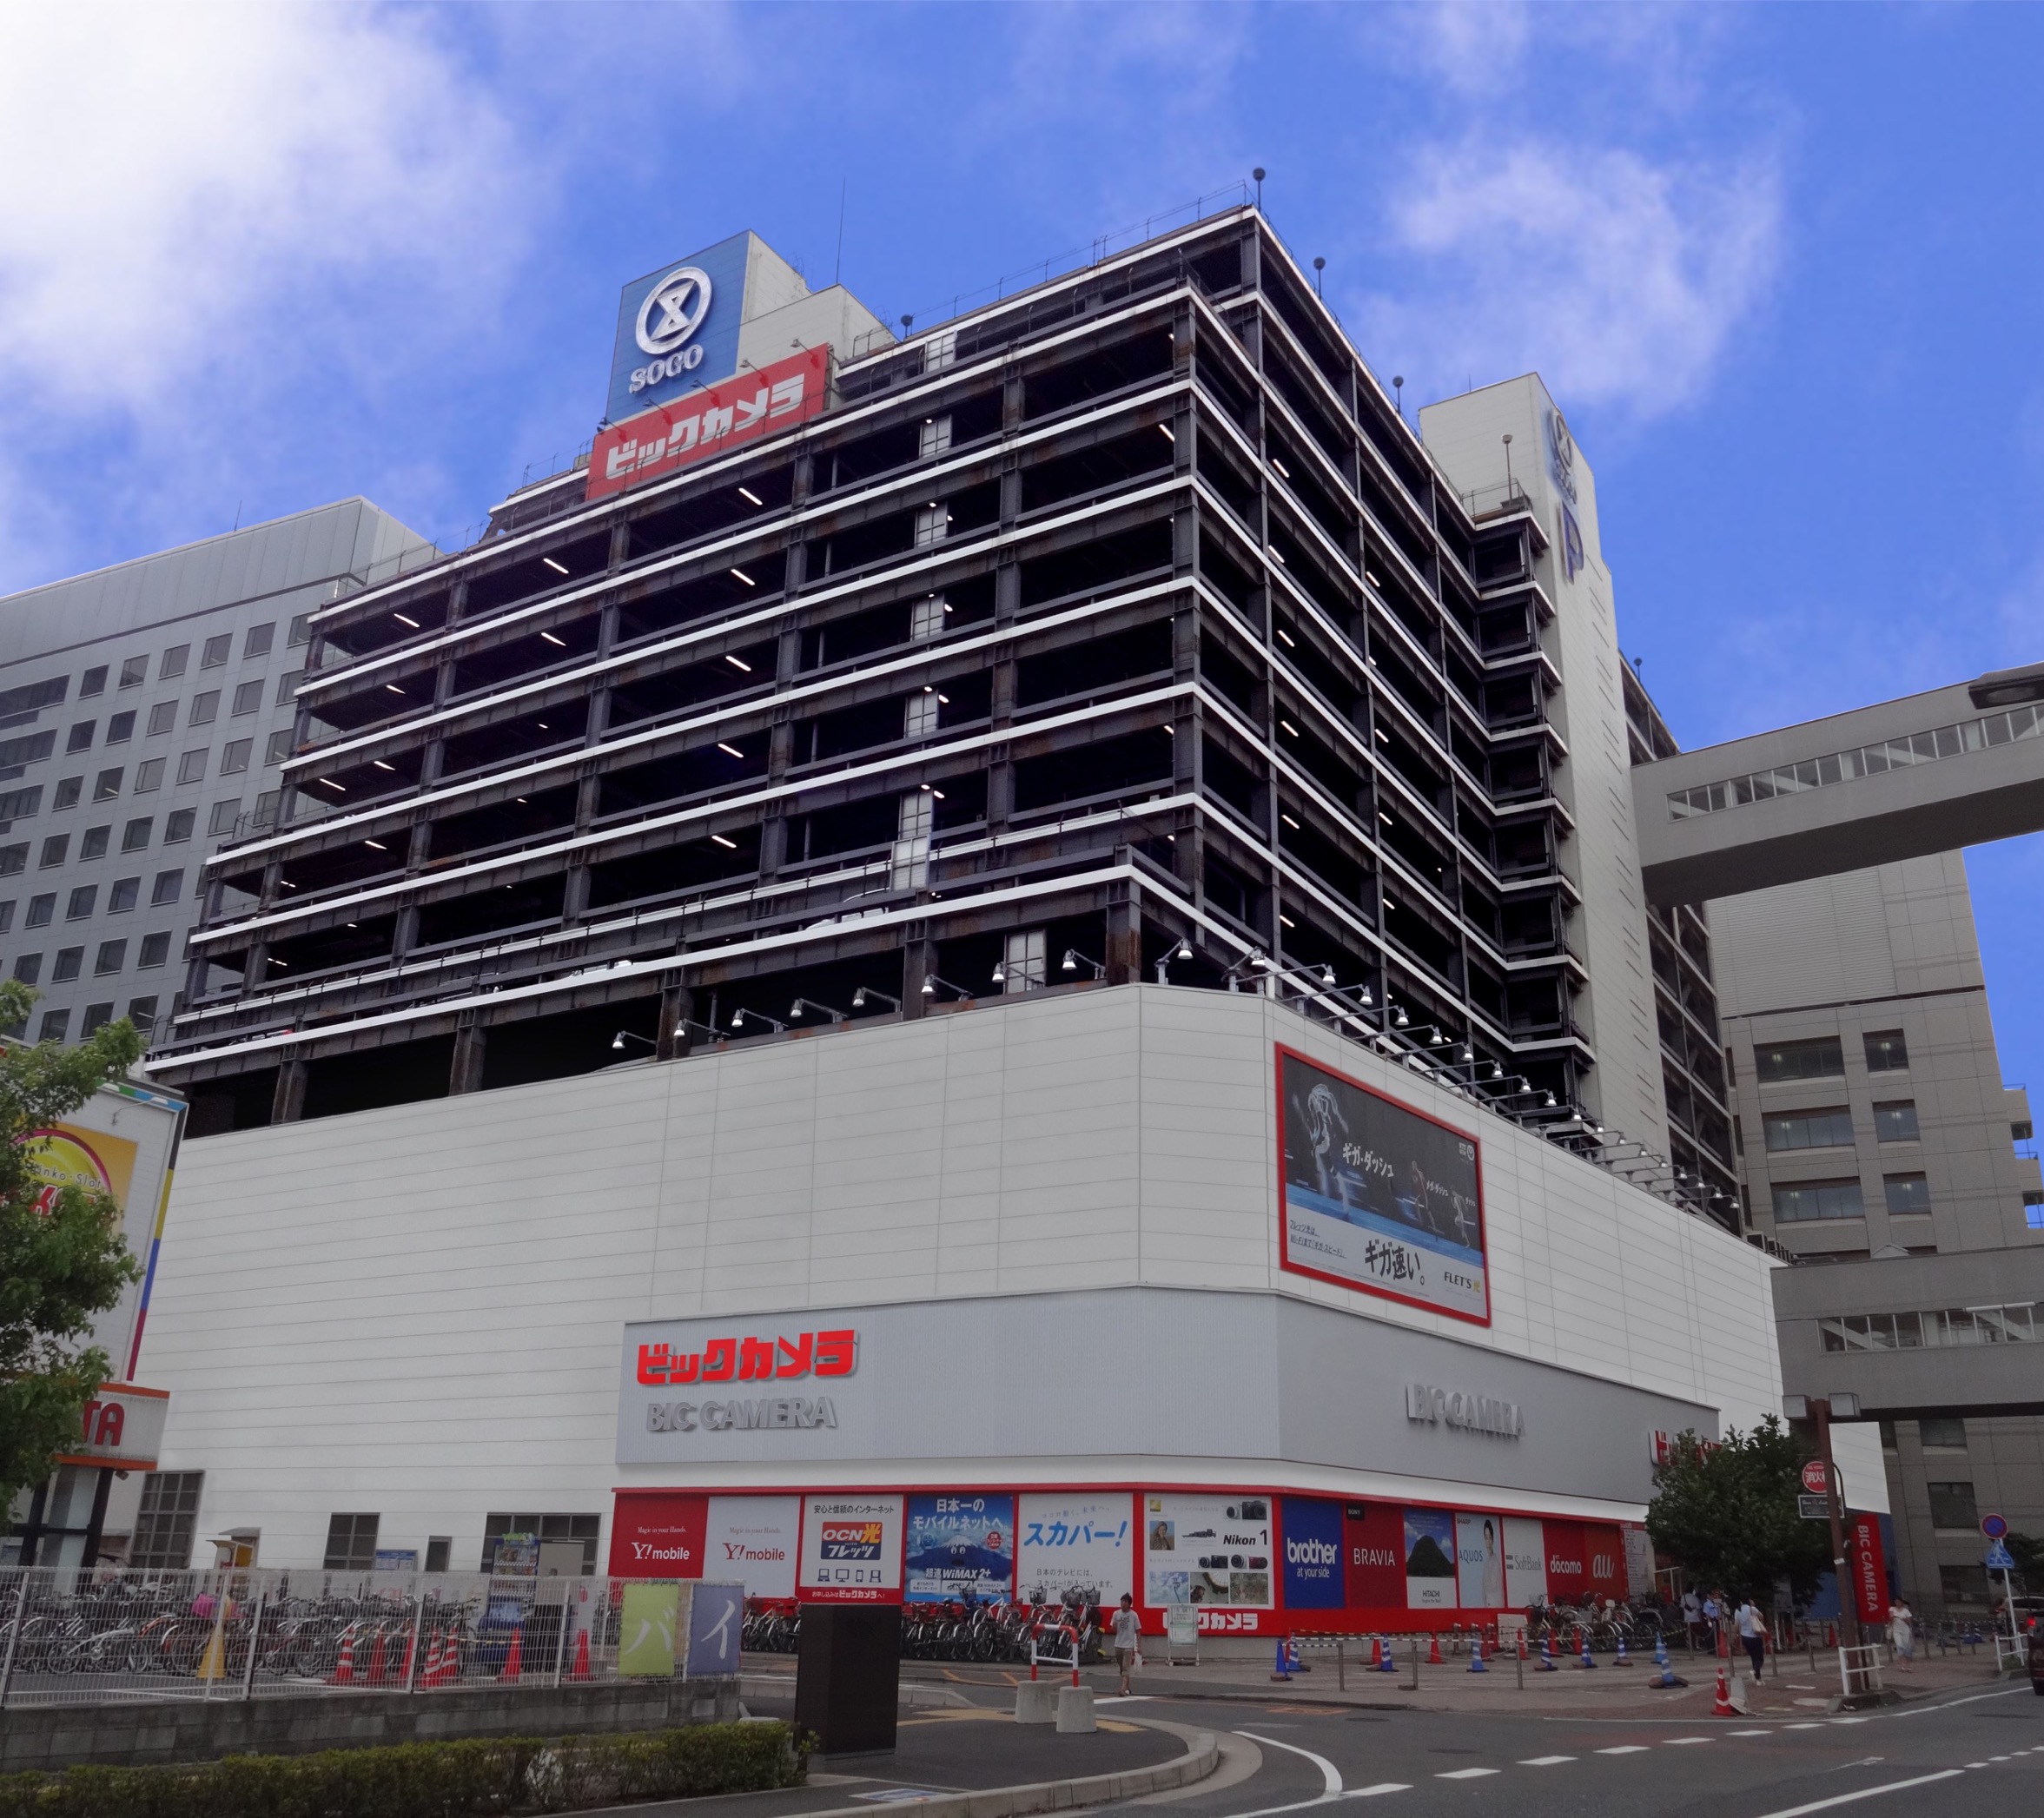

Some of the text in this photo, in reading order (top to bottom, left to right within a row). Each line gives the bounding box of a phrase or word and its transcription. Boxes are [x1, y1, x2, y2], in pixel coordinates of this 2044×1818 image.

[629, 344, 704, 394] SOGO
[605, 373, 805, 479] ビックカメラ
[76, 1173, 102, 1189] Slot
[1364, 1239, 1426, 1286] ギガ速い。
[636, 1329, 859, 1386] ビックカメラ
[646, 1396, 837, 1431] BIC CAMERA
[1407, 1384, 1525, 1438] BIC CAMERA
[813, 1504, 895, 1514] 安心と信頼のインターネット
[936, 1497, 985, 1513] 日本一の
[912, 1515, 1009, 1530] モバイルネットへ。
[1223, 1534, 1256, 1546] Nikon
[1260, 1529, 1267, 1545] 1
[828, 1545, 875, 1558] フレッツ
[1287, 1537, 1338, 1564] brother
[1353, 1547, 1396, 1567] BRAVIA
[1459, 1549, 1484, 1564] AQUOS
[1514, 1554, 1543, 1571] SoftBank
[1551, 1555, 1583, 1575] docomo
[1592, 1554, 1616, 1579] au
[1856, 1524, 1879, 1613] BIC CAMERA
[1296, 1565, 1331, 1581] at your side
[1162, 1611, 1259, 1630] クカメラ
